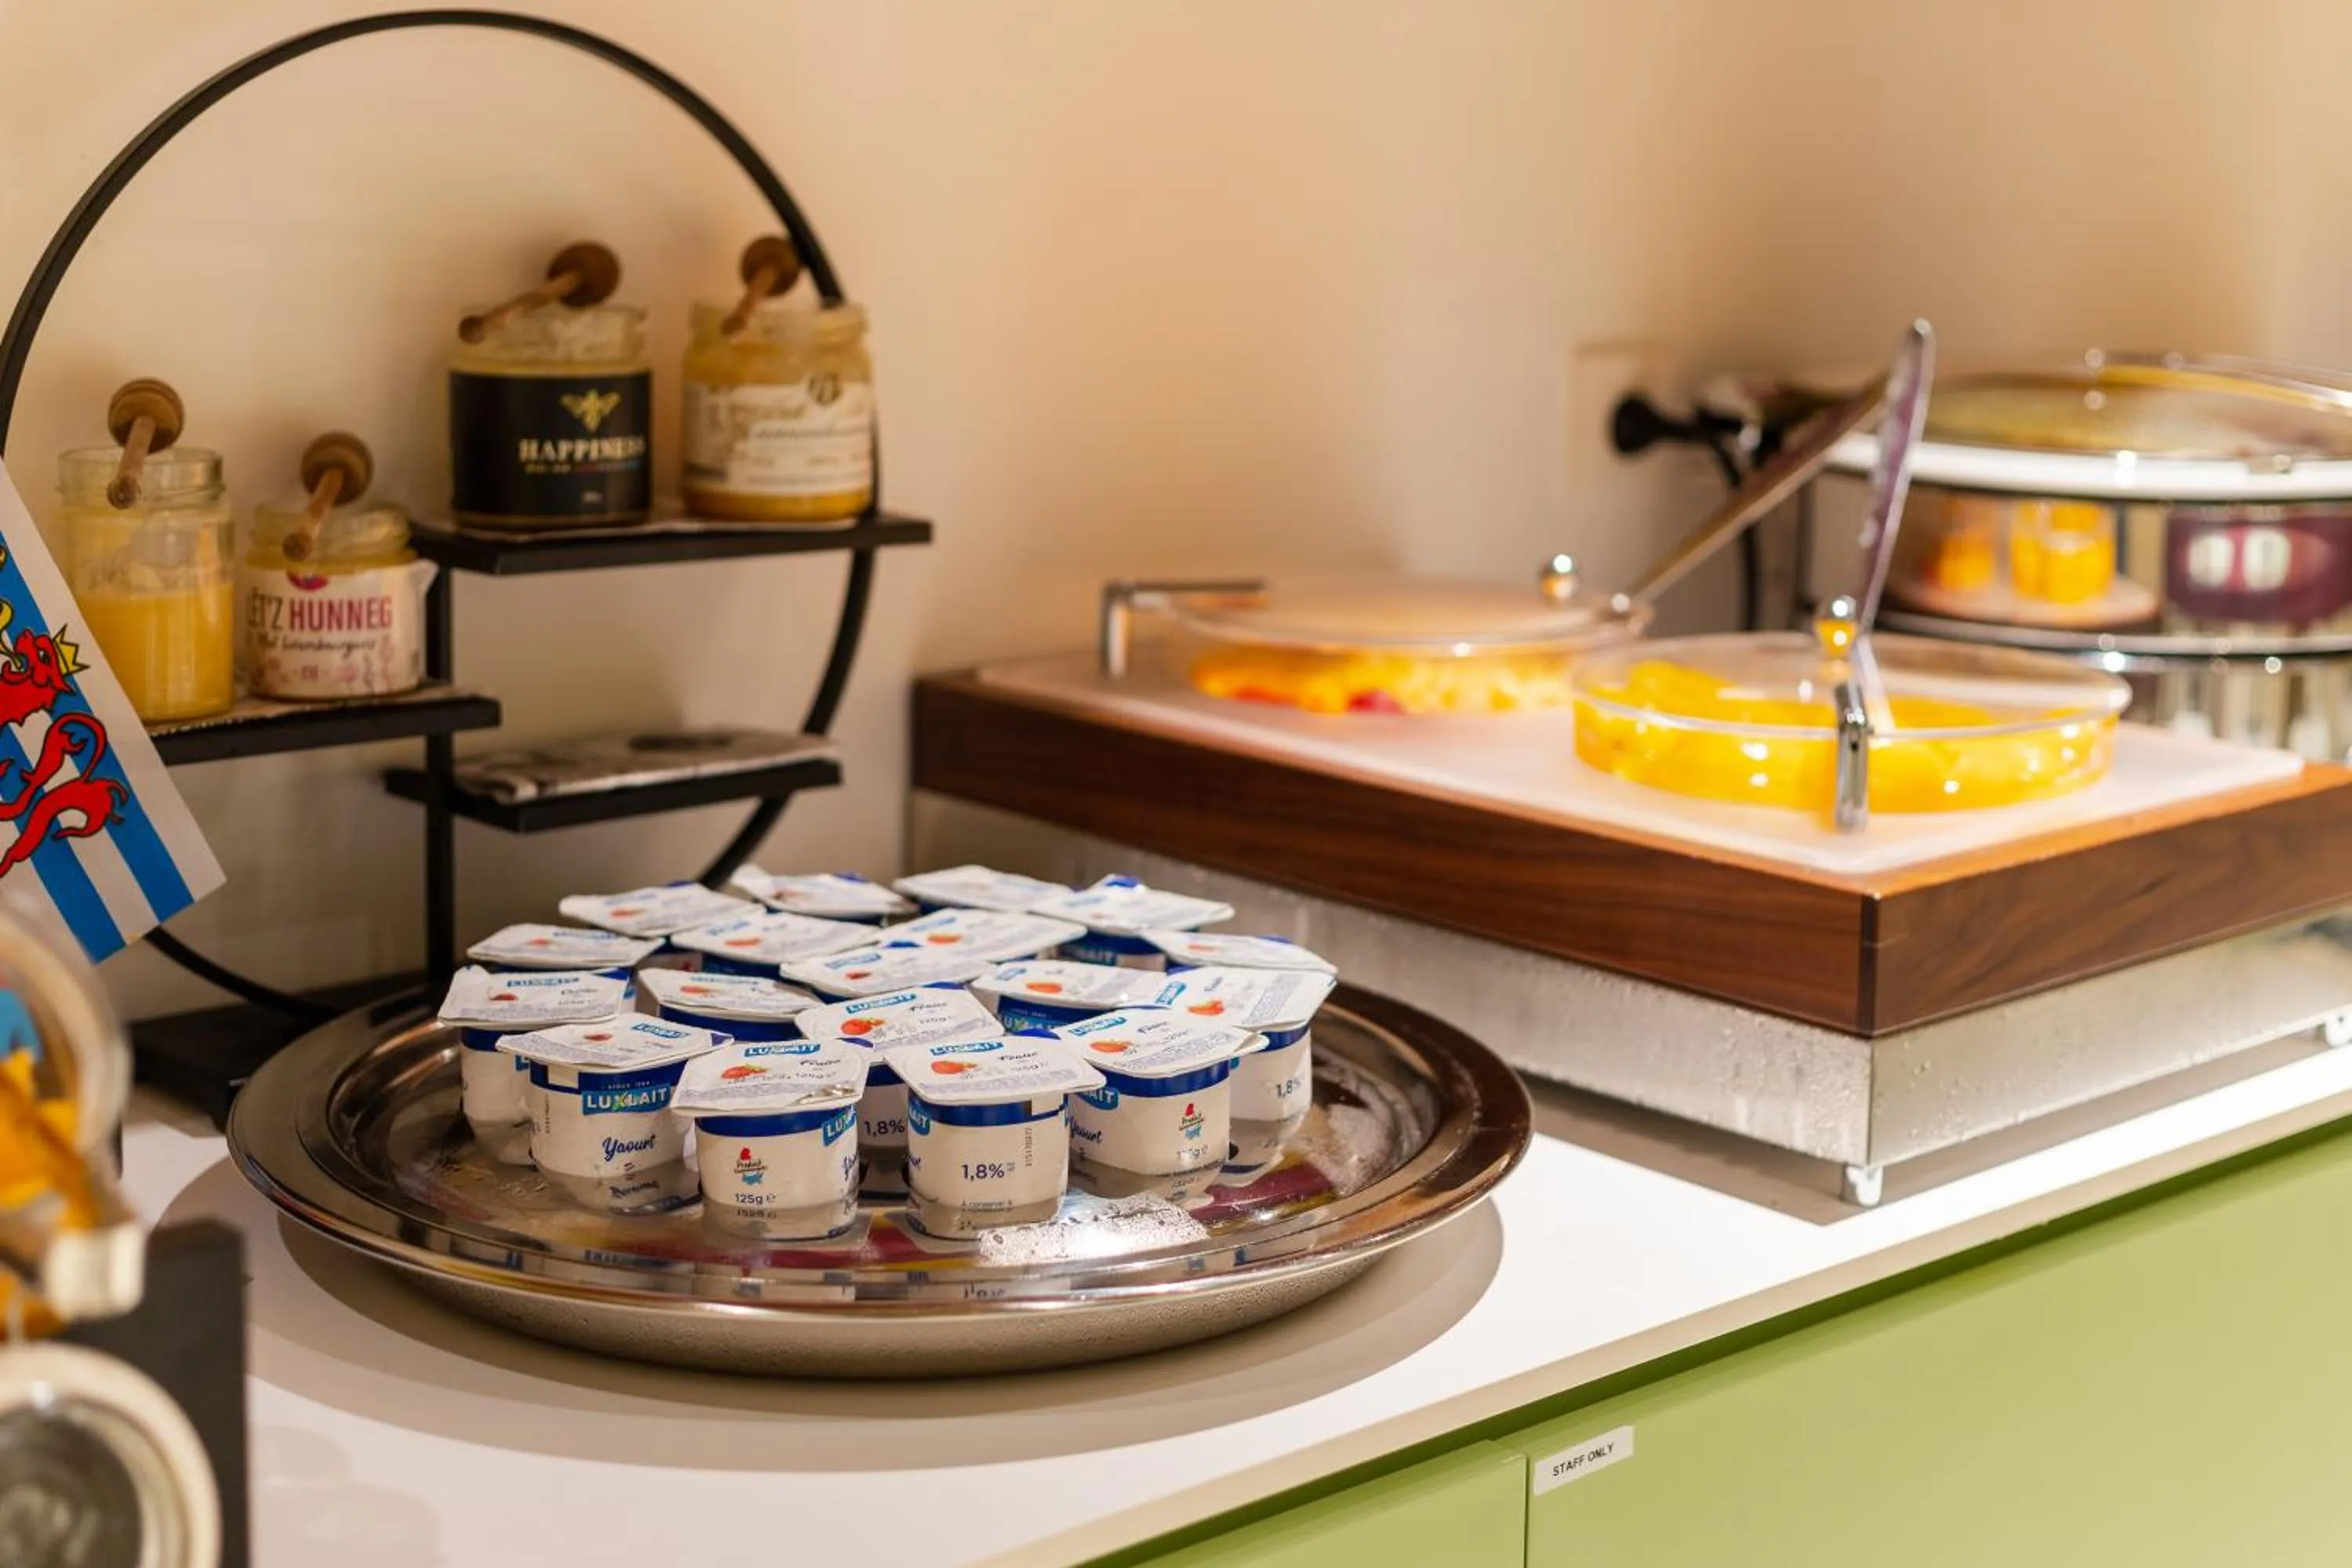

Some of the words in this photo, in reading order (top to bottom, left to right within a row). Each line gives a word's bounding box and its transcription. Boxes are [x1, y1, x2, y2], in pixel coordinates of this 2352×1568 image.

[289, 596, 392, 631] HUNNEG
[587, 1087, 667, 1111] LUXLAIT
[864, 1119, 905, 1137] 1,8%
[602, 1134, 656, 1163] Yaourt
[961, 1163, 1005, 1181] 1,8%
[735, 1193, 763, 1205] 125g
[1552, 1454, 1586, 1477] STAFF
[1587, 1443, 1614, 1462] ONLY
